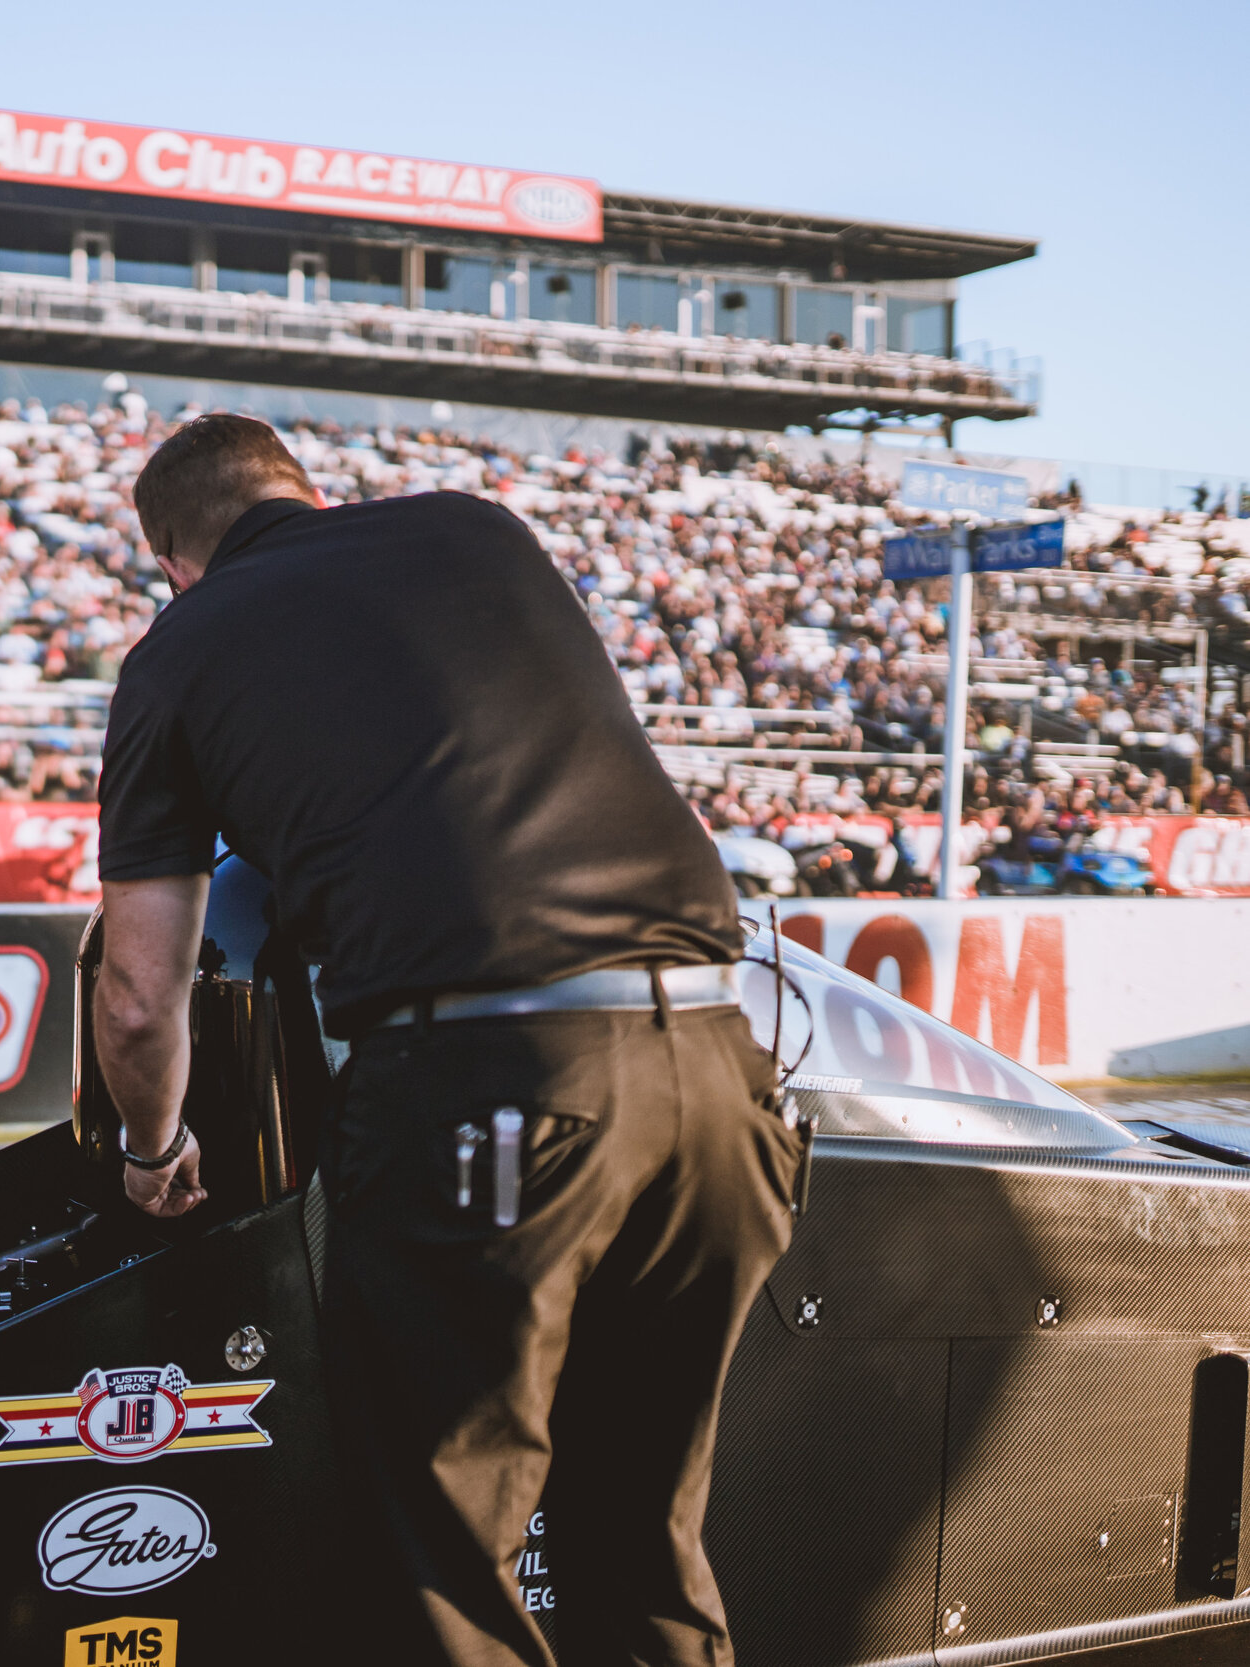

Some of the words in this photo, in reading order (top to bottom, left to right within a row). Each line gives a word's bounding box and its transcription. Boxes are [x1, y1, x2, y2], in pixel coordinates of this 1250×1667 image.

[136, 131, 287, 199] Club
[291, 147, 510, 205] RACEWAY
[108, 1374, 158, 1387] JUSTICE
[115, 1382, 152, 1394] BROS.
[50, 1502, 200, 1586] Gates
[79, 1626, 163, 1666] TMS
